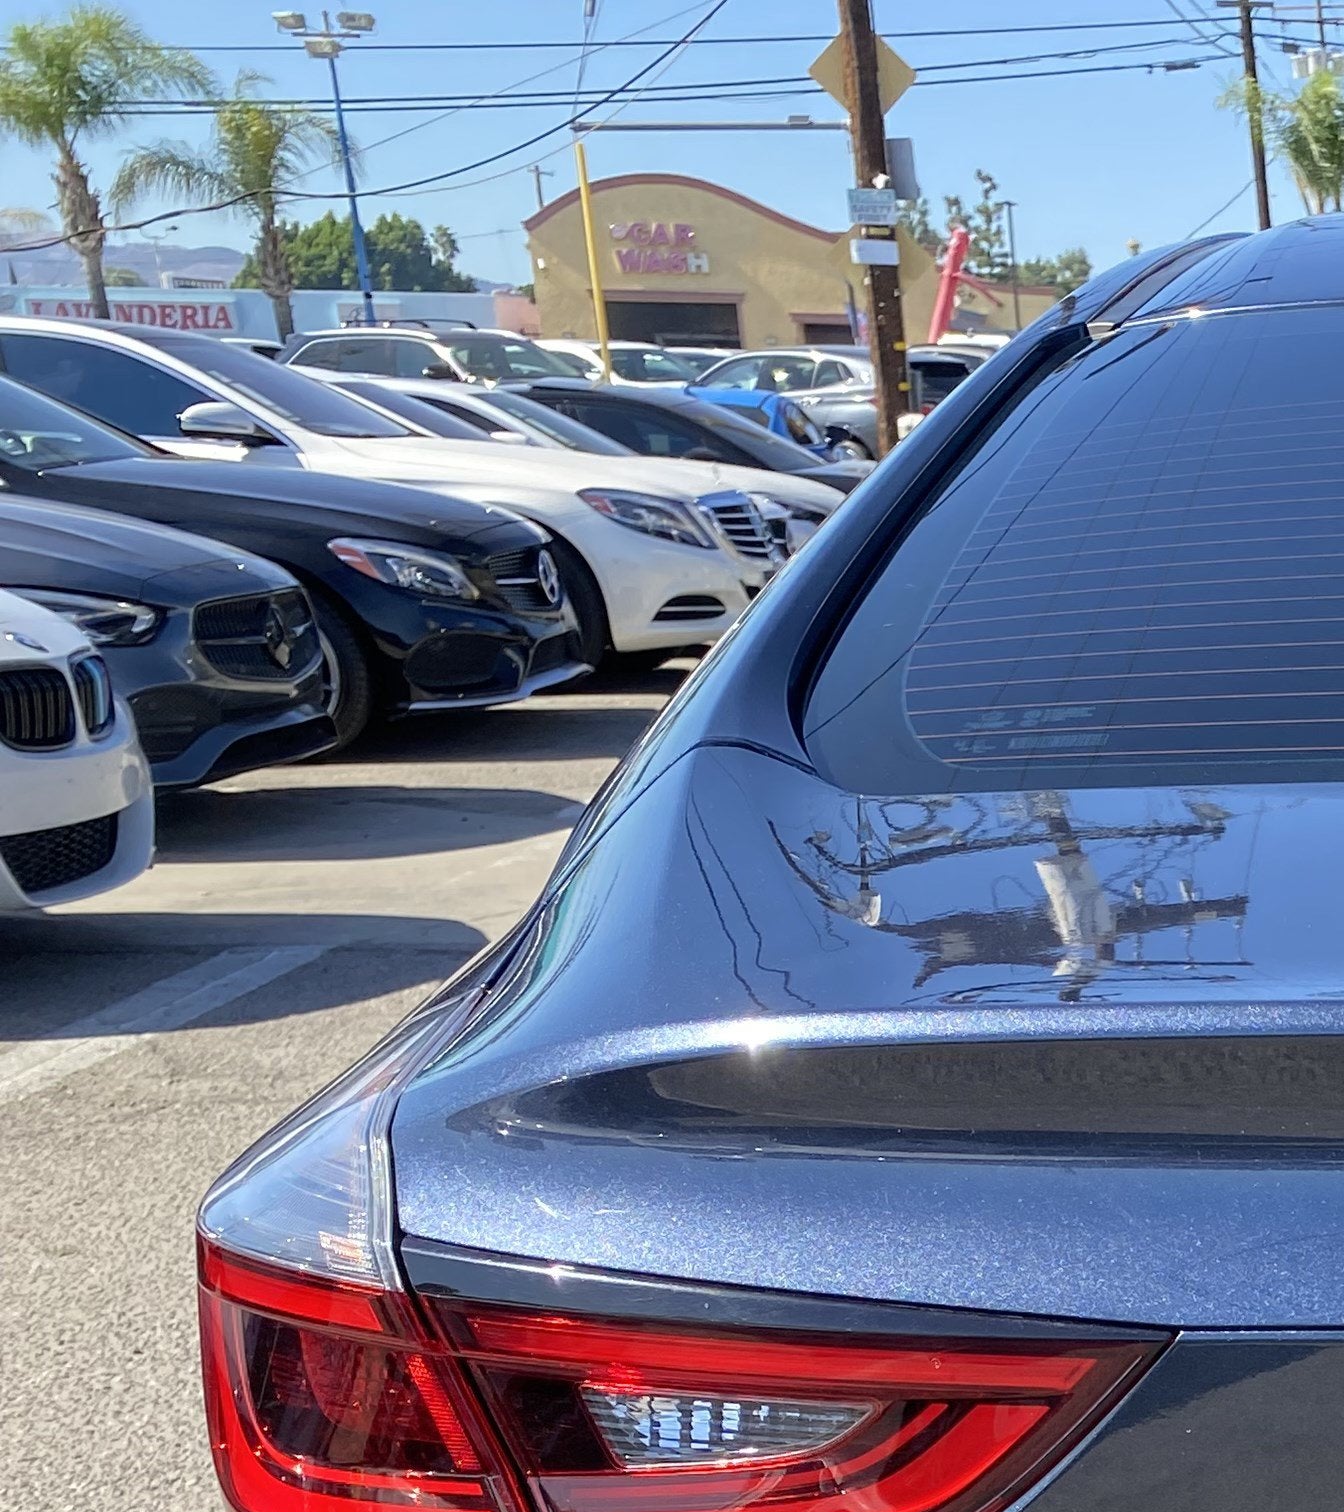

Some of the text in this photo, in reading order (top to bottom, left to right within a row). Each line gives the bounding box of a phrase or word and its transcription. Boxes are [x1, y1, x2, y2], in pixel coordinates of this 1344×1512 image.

[628, 223, 696, 246] CAR
[614, 249, 710, 275] WASH
[31, 301, 234, 330] LAVNDERIA
